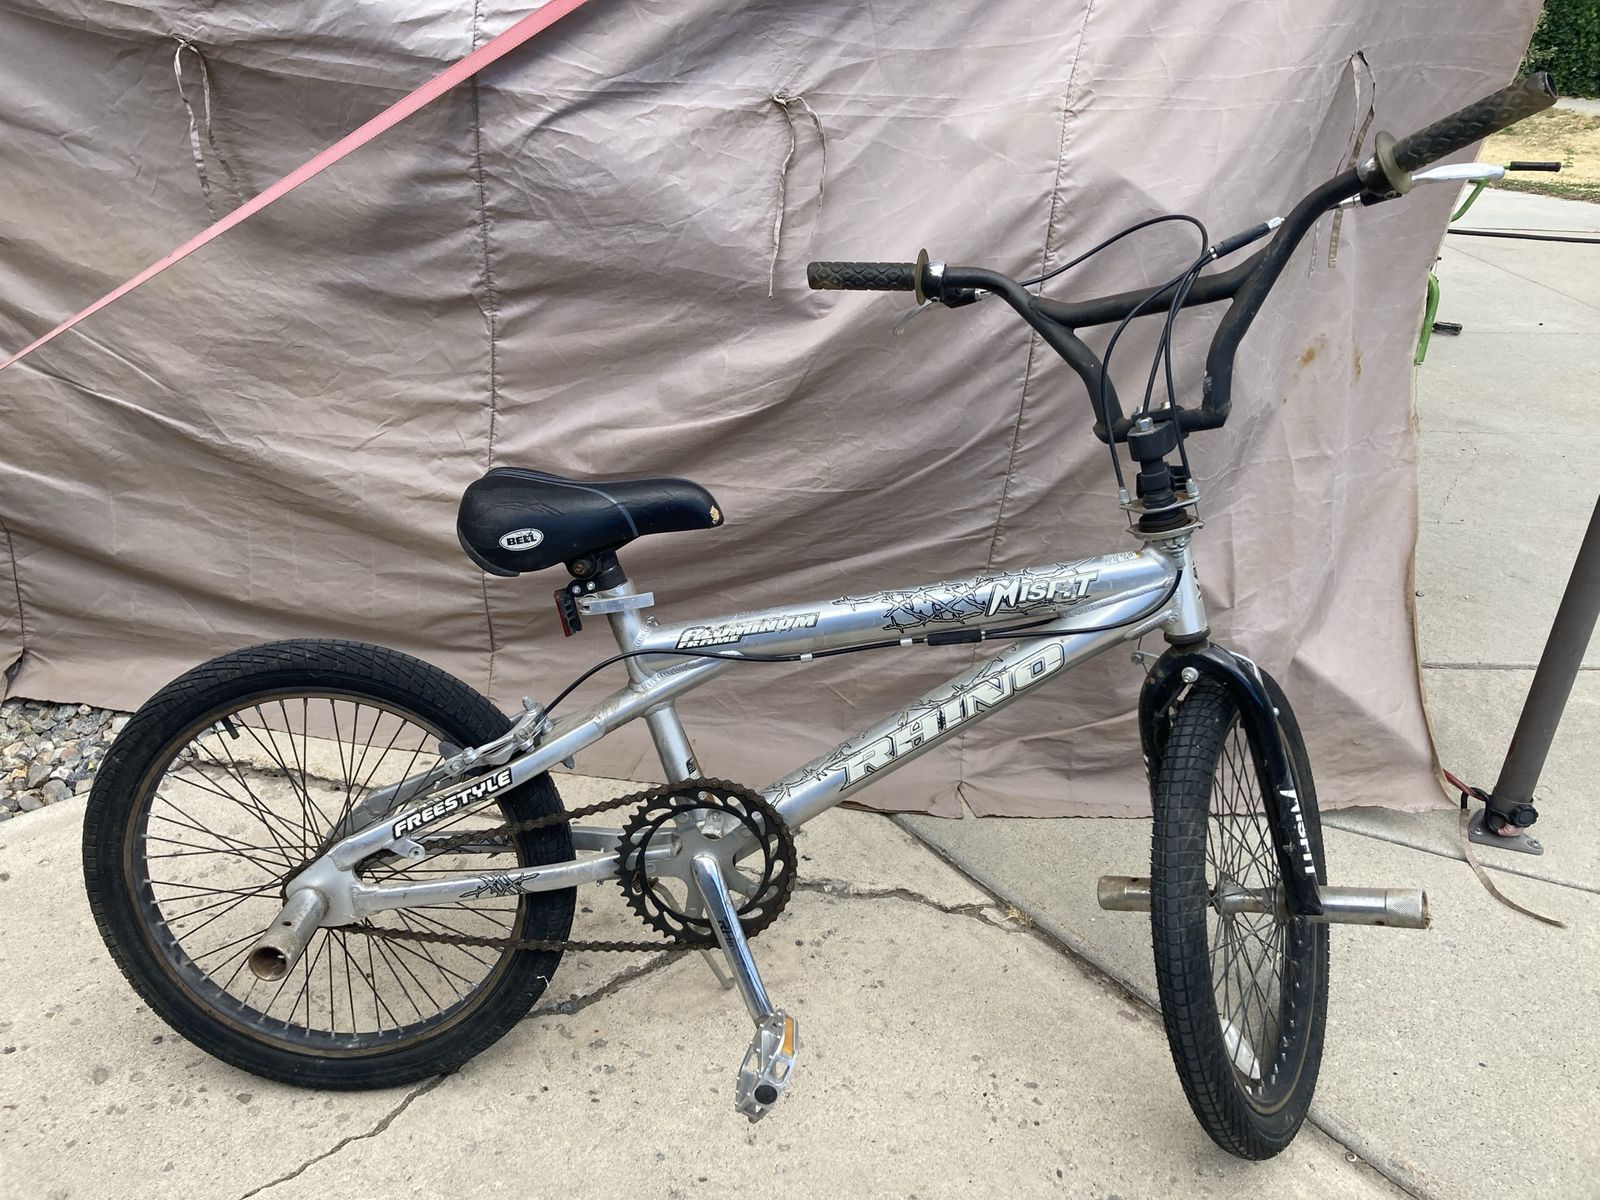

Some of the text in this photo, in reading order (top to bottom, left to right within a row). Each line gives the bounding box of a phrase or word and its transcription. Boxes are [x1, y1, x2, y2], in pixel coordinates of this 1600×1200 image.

[677, 634, 741, 649] FRAME
[836, 643, 1065, 789] RHINO
[394, 769, 512, 839] FREESTYLE
